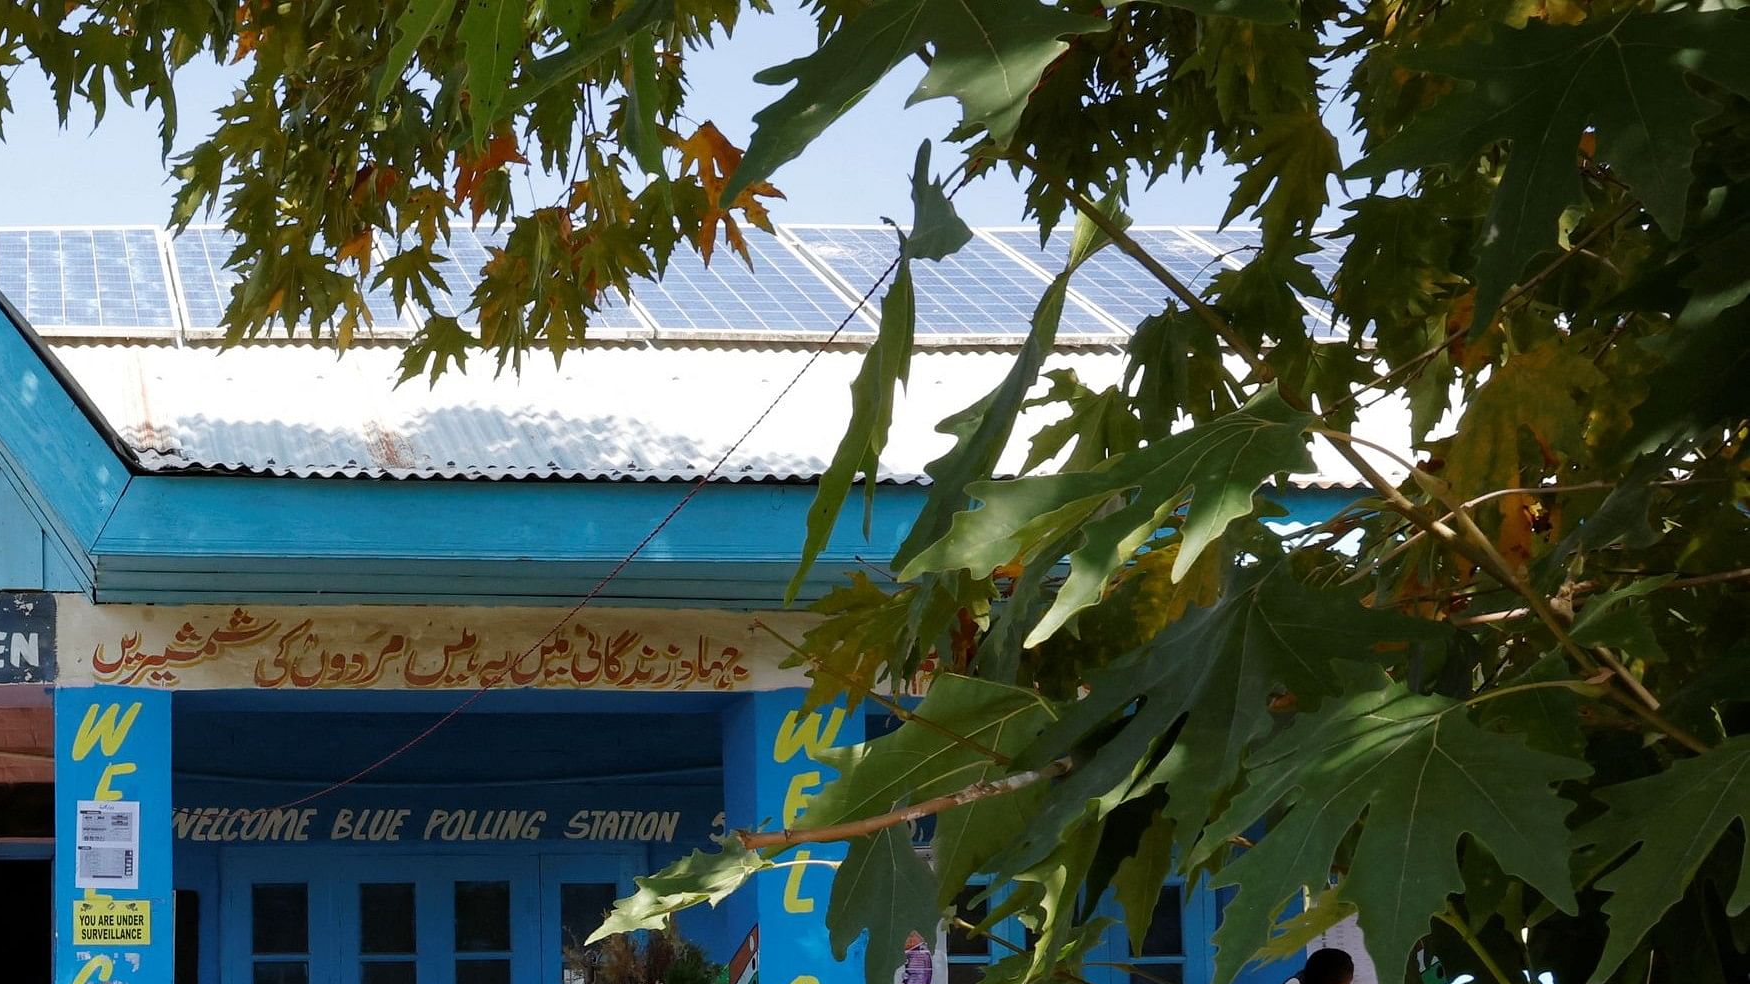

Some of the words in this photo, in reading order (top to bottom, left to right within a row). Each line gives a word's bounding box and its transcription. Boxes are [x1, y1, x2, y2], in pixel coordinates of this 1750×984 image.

[254, 617, 314, 688] کی
[172, 807, 318, 842] WELCOME
[330, 808, 411, 842] BLUE
[423, 809, 548, 842] POLLING
[562, 809, 681, 842] STATION
[79, 914, 98, 926] YOU
[98, 914, 115, 926] ARE
[116, 914, 144, 926] UNDER
[81, 928, 142, 940] SURVEILLANCE
